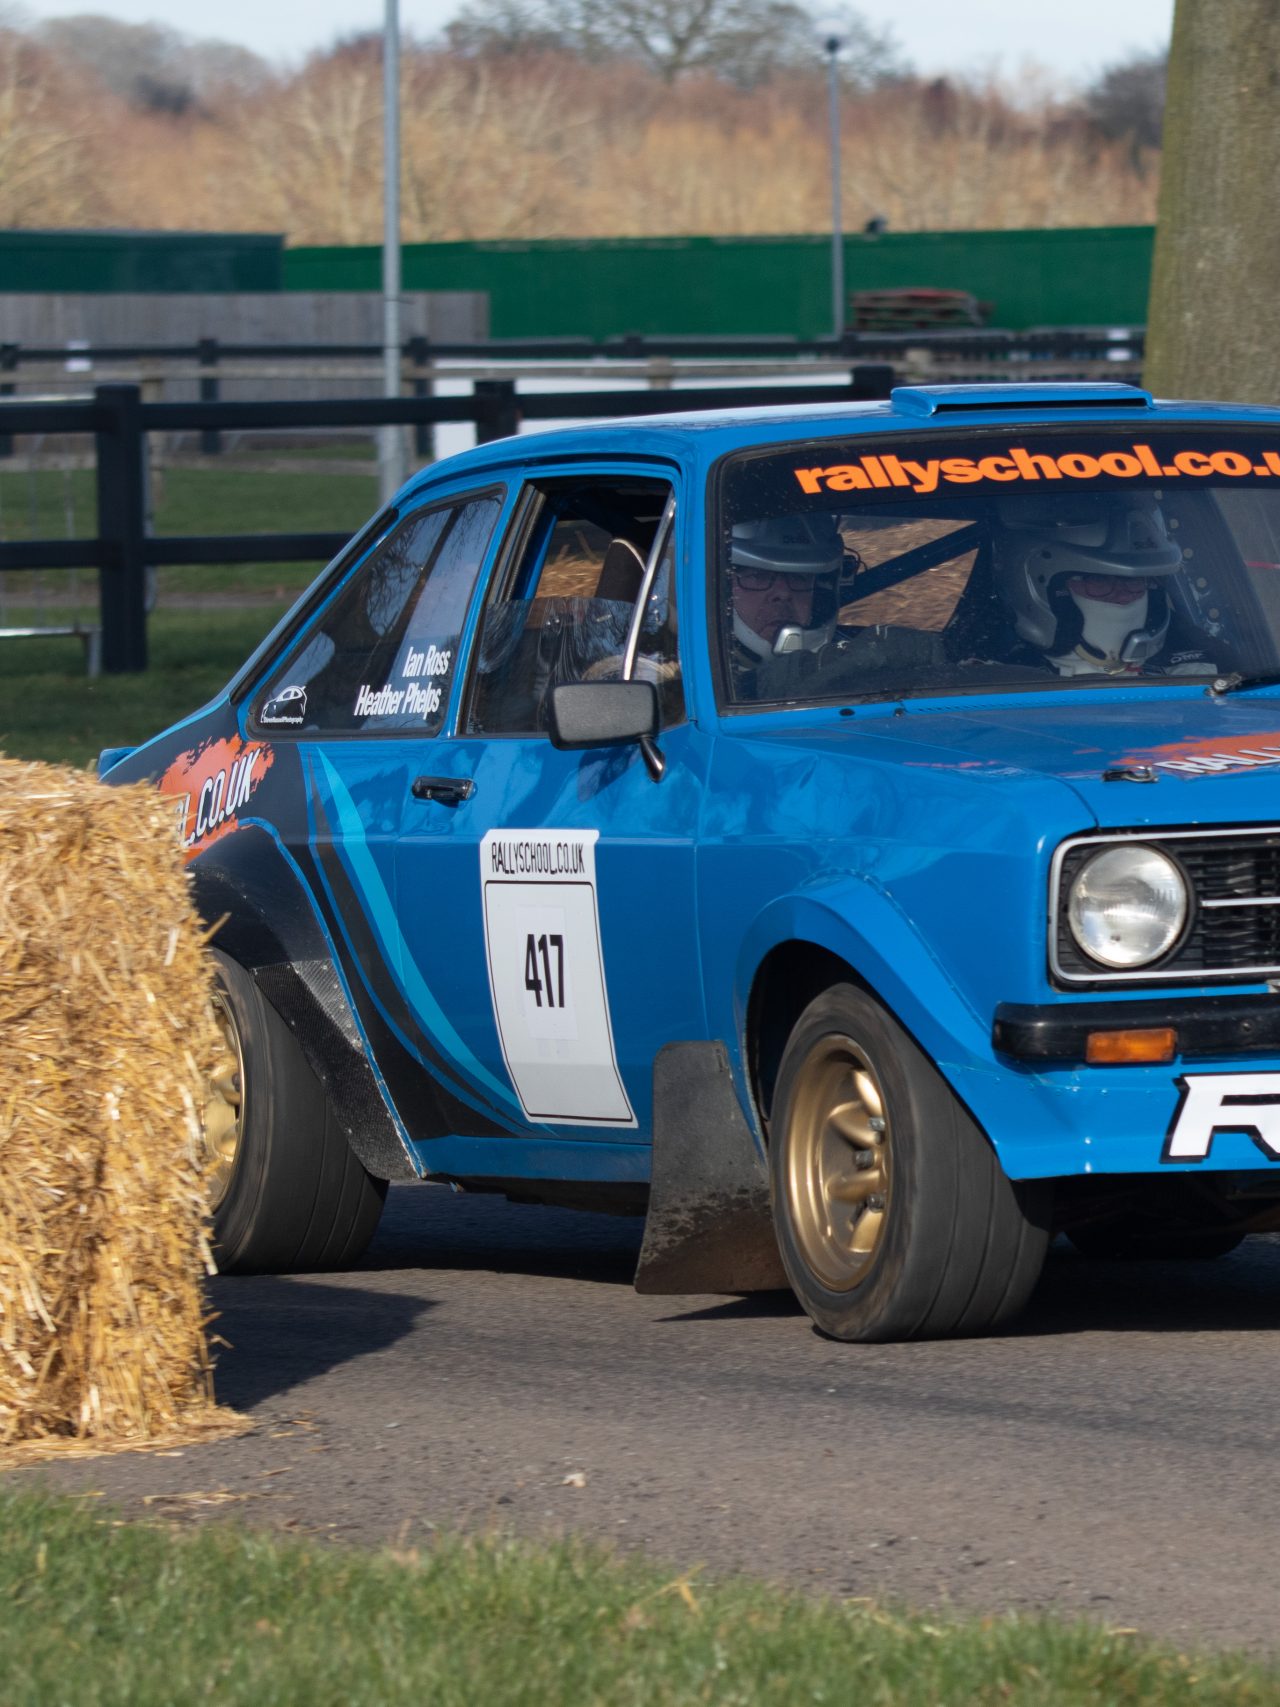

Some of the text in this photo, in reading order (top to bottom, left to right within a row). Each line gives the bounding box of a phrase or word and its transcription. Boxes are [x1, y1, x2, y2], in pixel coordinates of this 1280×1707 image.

[402, 645, 451, 677] Ian Ross
[354, 682, 442, 720] Heather Phelps
[492, 842, 585, 874] RALLYSCHOOL.CO.UK
[525, 934, 565, 1008] 417
